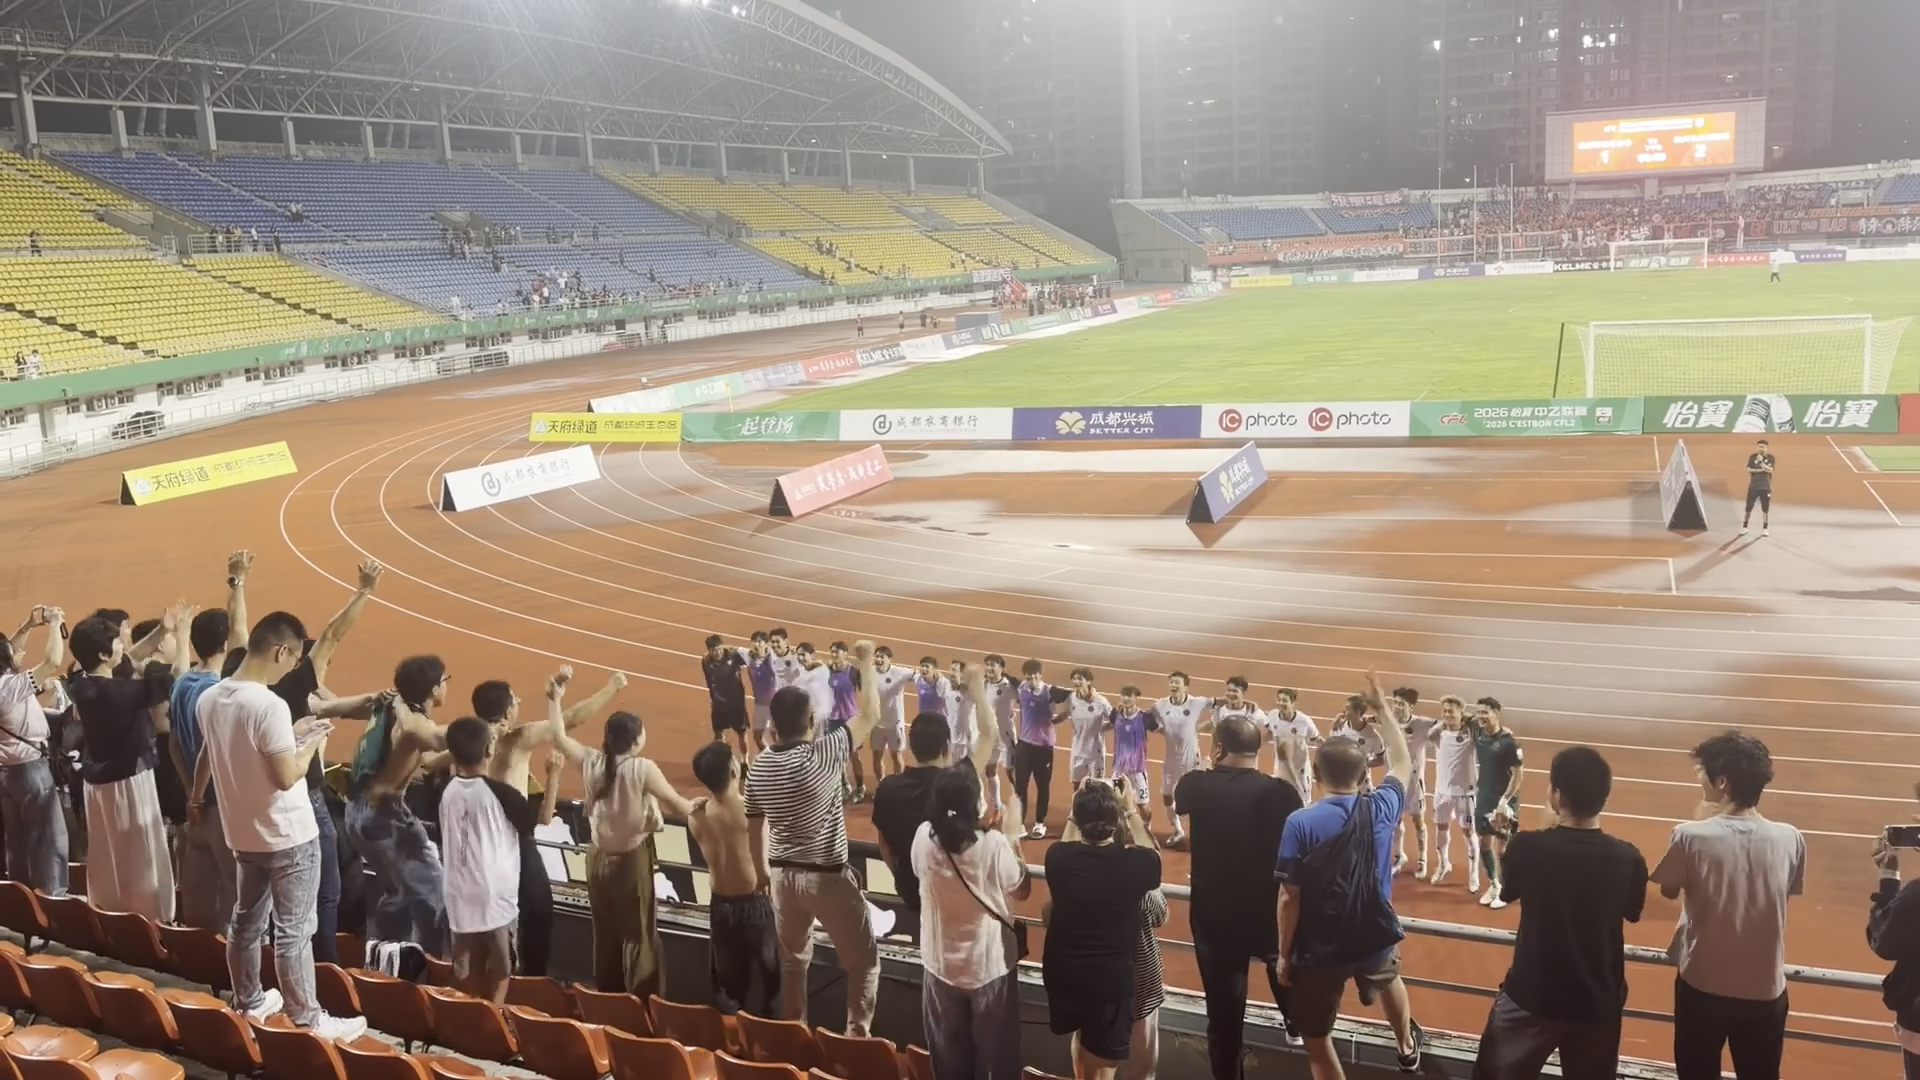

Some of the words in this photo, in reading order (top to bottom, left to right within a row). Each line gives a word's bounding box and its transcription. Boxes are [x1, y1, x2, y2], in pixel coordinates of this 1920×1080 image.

[1554, 261, 1592, 271] KELME
[1089, 411, 1154, 427] 成都兴城
[1245, 412, 1298, 431] photo
[1336, 411, 1392, 430] photo
[1662, 400, 1734, 428] 怡寶
[1802, 399, 1879, 428] 怡寶
[547, 419, 598, 434] 天府绿道
[1089, 427, 1130, 435] BETTER
[1485, 419, 1507, 428] 2026
[1553, 419, 1576, 427] CFL2
[151, 465, 211, 492] 天府绿道
